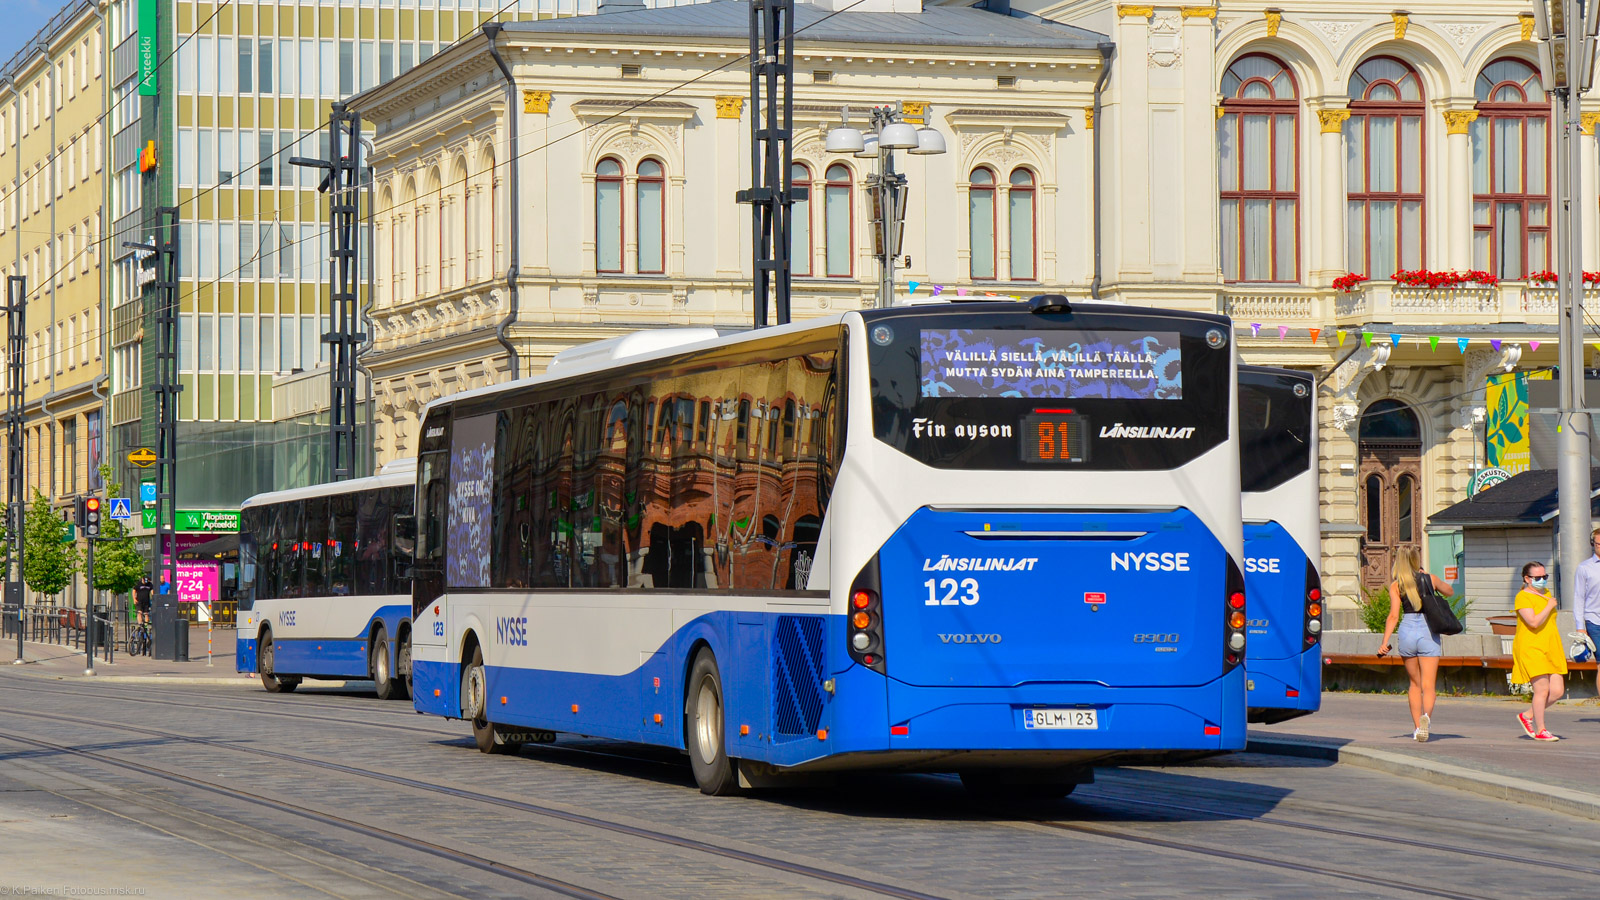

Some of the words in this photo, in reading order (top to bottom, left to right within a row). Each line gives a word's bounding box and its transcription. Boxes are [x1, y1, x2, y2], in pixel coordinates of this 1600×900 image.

[141, 36, 154, 87] Apteekki
[945, 349, 997, 361] VÄLILLÄ
[1001, 350, 1047, 363] SIELLÄ,
[1052, 350, 1102, 363] VÄLILLÄ
[1106, 351, 1157, 364] TÄÄLLÄ,
[945, 367, 988, 377] MUTTA
[991, 366, 1033, 378] SYDÄN
[1036, 368, 1065, 378] AINA
[1069, 369, 1159, 379] TAMPEREELLA.
[954, 424, 1012, 440] ayson
[1099, 422, 1196, 439] LÄNSILINJAT
[1038, 421, 1070, 459] 81
[457, 481, 475, 497] NYSSE
[201, 512, 238, 523] Yliopiston
[462, 507, 476, 523] KIVA
[203, 520, 238, 530] Apteekki
[923, 554, 1039, 571] LÄNSILINJAT
[1110, 552, 1190, 571] NYSSE
[1243, 557, 1280, 573] SSE
[176, 571, 204, 579] ma-pe
[176, 580, 204, 591] 7-24
[924, 577, 980, 606] 123
[180, 592, 201, 600] la-su
[279, 610, 296, 626] NYSSE
[433, 621, 444, 637] 123
[496, 616, 528, 646] NYSSE
[937, 633, 1002, 644] VOLVO
[1133, 633, 1180, 643] 8900
[500, 732, 554, 741] VOLVO
